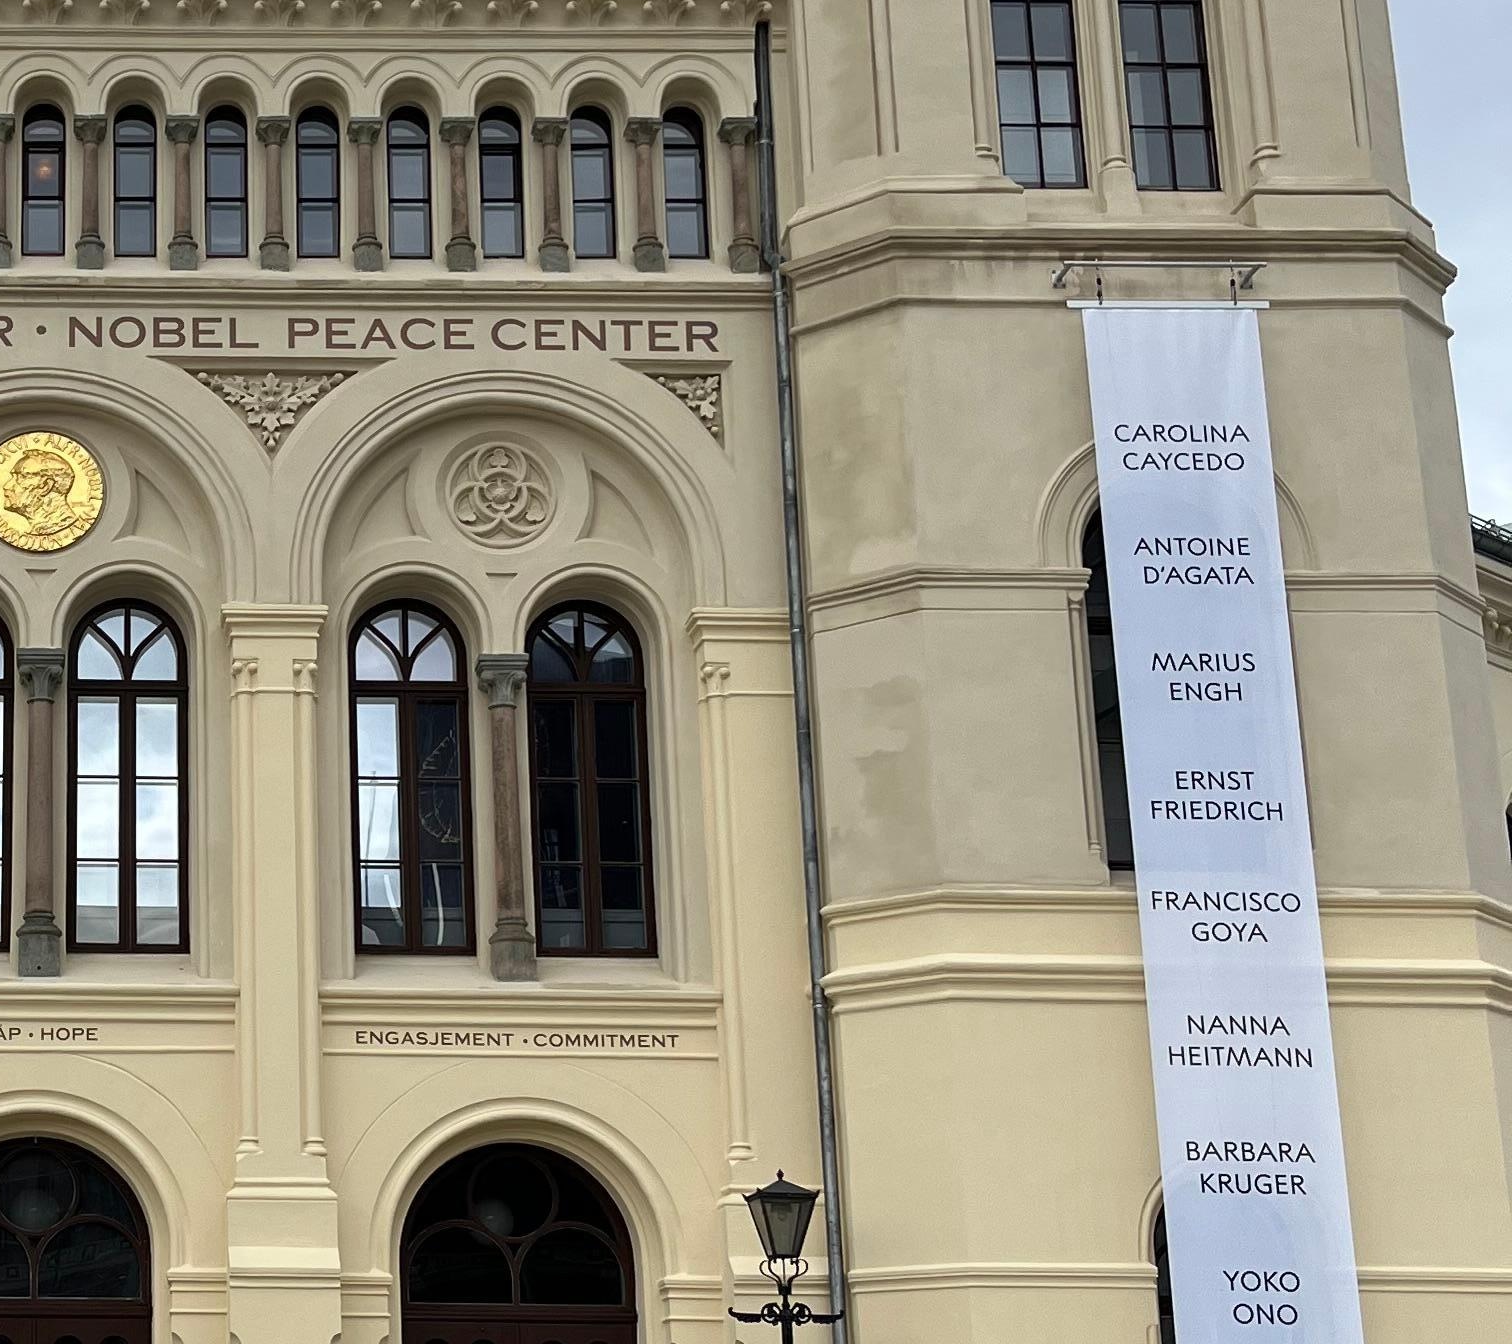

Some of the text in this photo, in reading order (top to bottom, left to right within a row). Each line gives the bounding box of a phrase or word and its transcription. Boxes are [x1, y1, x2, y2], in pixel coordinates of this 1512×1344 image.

[69, 316, 259, 348] NOBEL
[288, 318, 474, 349] PEACE
[491, 319, 719, 352] CENTER
[1115, 425, 1249, 442] CAROLINA
[1123, 453, 1244, 470] CAYCEDO
[1134, 538, 1250, 556] ANTOINE
[1144, 566, 1254, 584] D'AGATA
[1152, 653, 1255, 671] MARIUS
[1170, 683, 1242, 701] ENGH
[1176, 771, 1254, 790] ERNST
[1151, 801, 1282, 821] FRIEDRICH
[1152, 891, 1300, 912] FRANCISCO
[1192, 922, 1268, 942] GOYA
[41, 1028, 98, 1040] HOPE
[1188, 1015, 1290, 1036] NANNA
[355, 1030, 515, 1047] ENGASJEMENT
[533, 1033, 680, 1048] COMMITMENT
[1169, 1046, 1312, 1067] HEITMANN
[1186, 1141, 1315, 1163] BARBARA
[1201, 1174, 1306, 1195] KRUGER
[1223, 1271, 1300, 1292] YOKO
[1233, 1304, 1297, 1325] ONO
